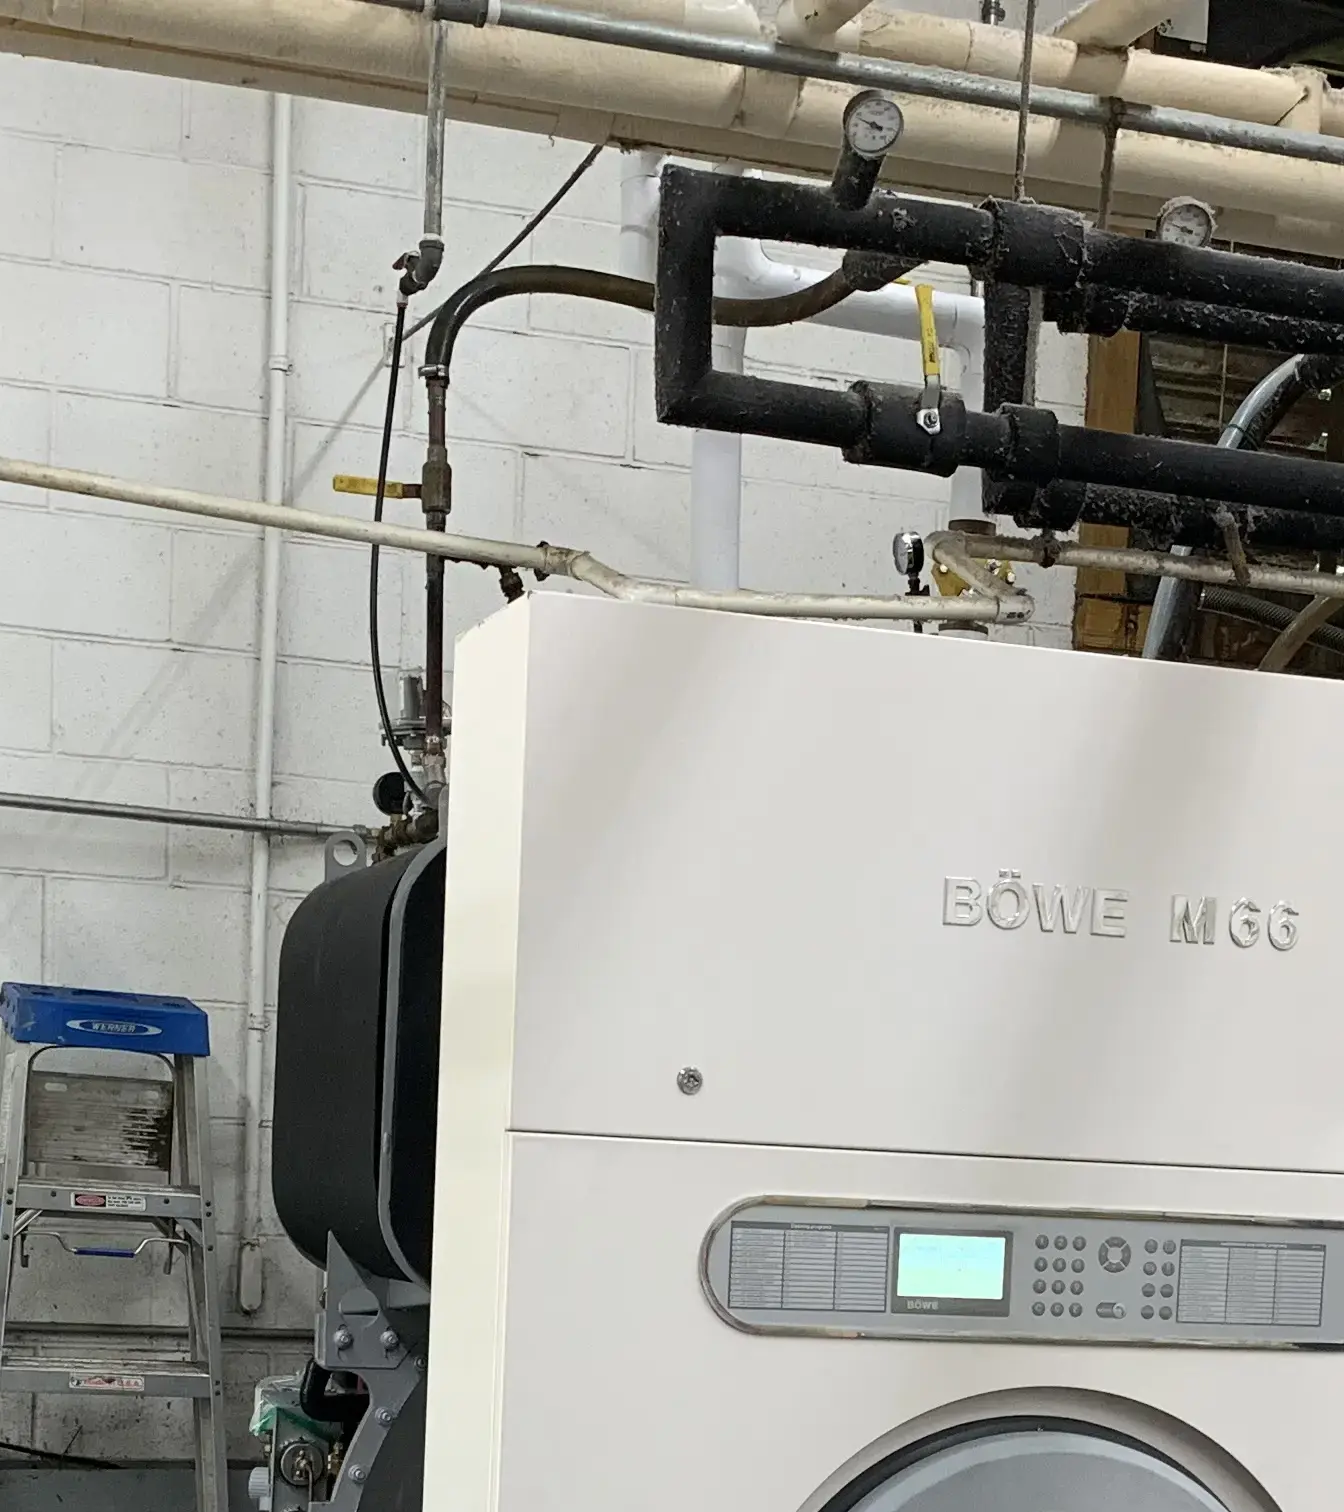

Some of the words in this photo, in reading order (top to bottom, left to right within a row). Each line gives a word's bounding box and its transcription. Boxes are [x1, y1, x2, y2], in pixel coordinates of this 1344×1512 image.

[942, 868, 1130, 938] BÖWE
[1169, 893, 1300, 951] M66
[93, 1022, 136, 1033] WERNER
